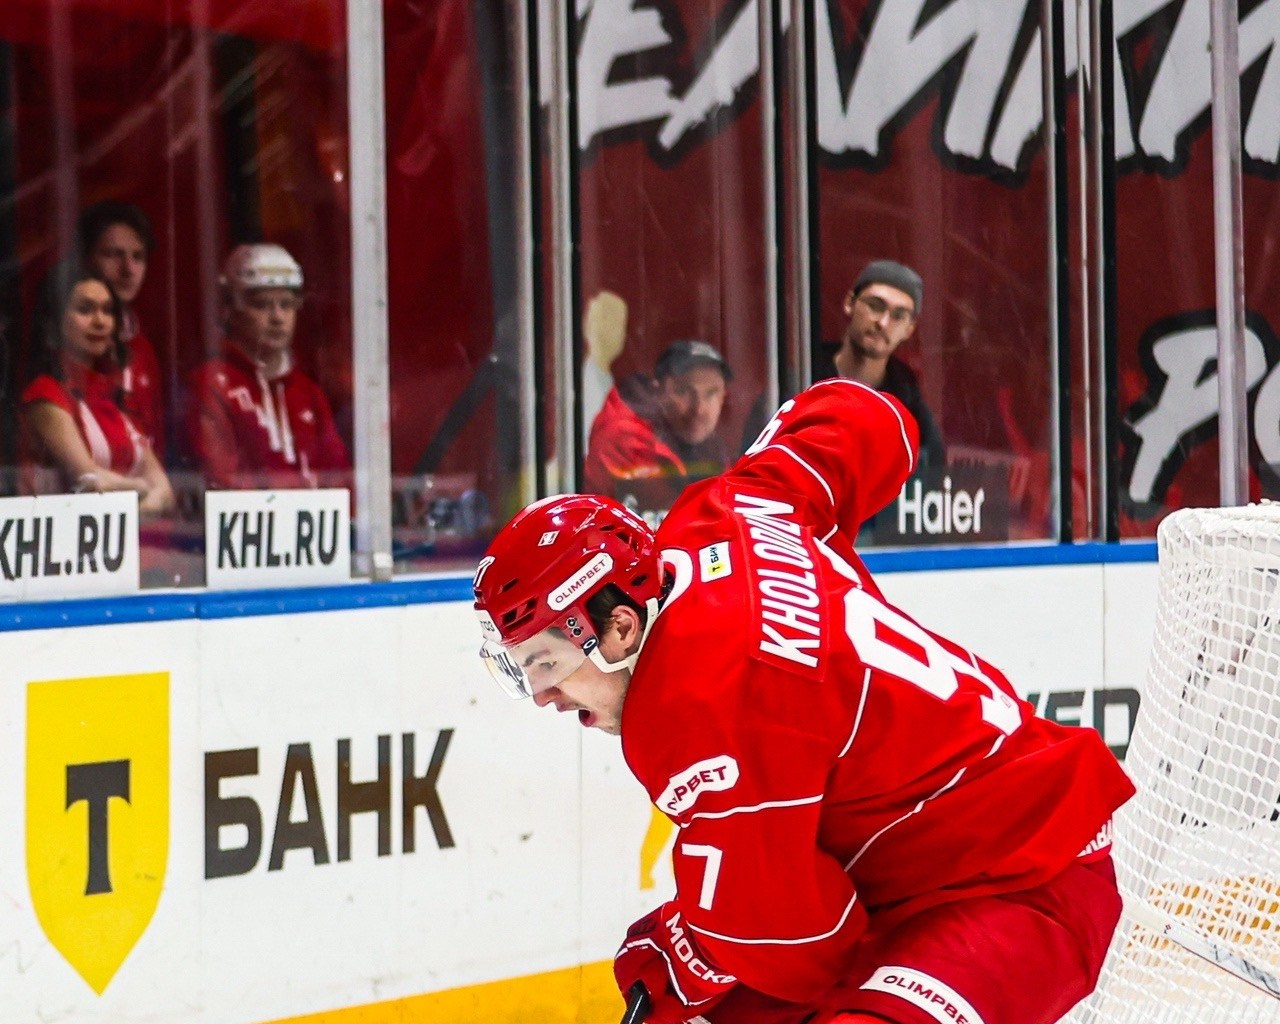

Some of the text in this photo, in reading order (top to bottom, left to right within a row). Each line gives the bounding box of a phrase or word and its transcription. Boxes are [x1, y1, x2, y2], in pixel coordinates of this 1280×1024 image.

[898, 476, 985, 535] Haier
[219, 509, 339, 569] KHL.RU
[554, 558, 606, 605] OLIMPBET
[204, 727, 457, 879] БАНК
[681, 842, 724, 911] 7
